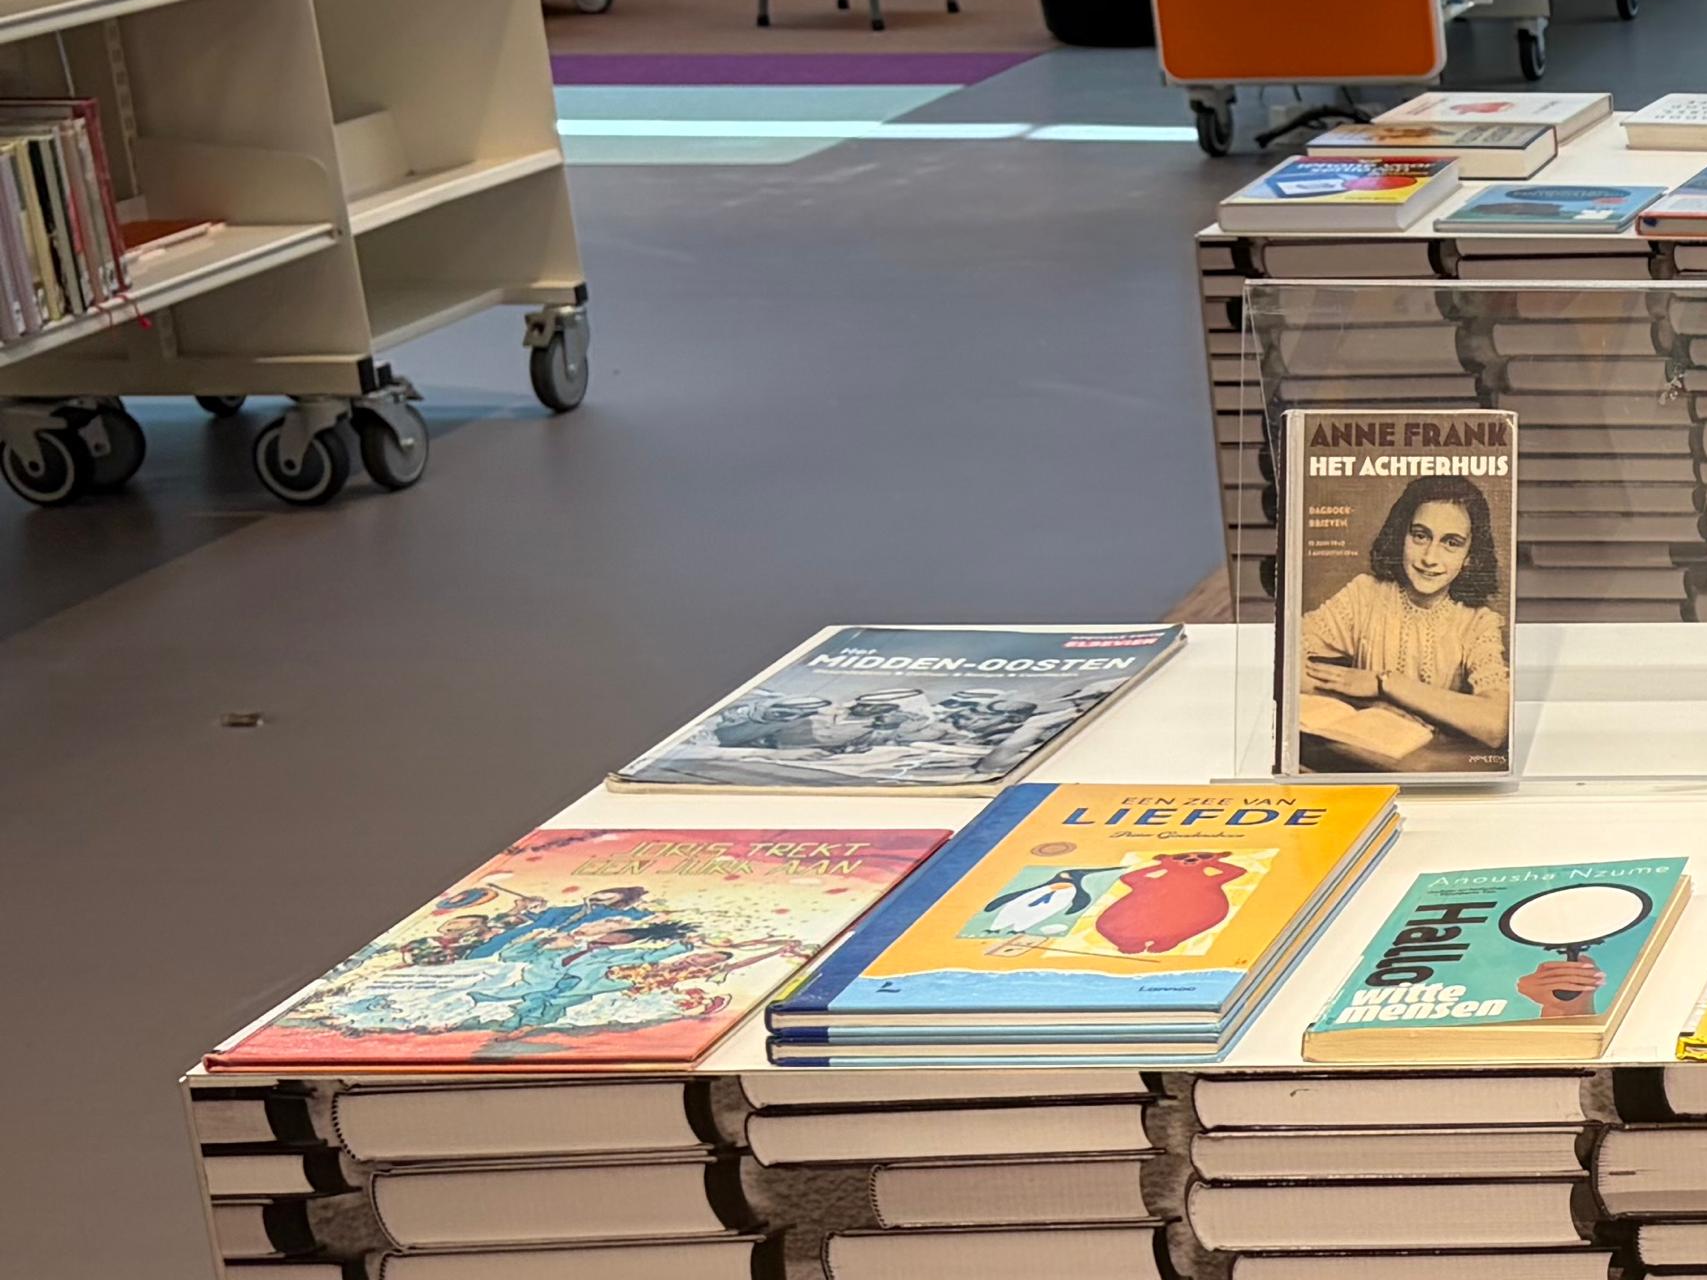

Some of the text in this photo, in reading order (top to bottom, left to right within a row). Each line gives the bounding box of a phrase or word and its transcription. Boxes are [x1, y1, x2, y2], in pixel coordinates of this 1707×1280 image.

[1310, 422, 1507, 448] ANNE FRANK
[1310, 455, 1508, 476] HET ACHTERHUIS
[809, 654, 1136, 672] MIDDEN-OOSTEN
[1122, 797, 1297, 806] EEN ZEE VAN
[1061, 807, 1328, 826] LIEFDE
[1428, 865, 1671, 888] Anousha Nzume
[1365, 901, 1498, 987] Hallo
[1351, 981, 1468, 1006] witte
[1333, 997, 1508, 1025] mensen
